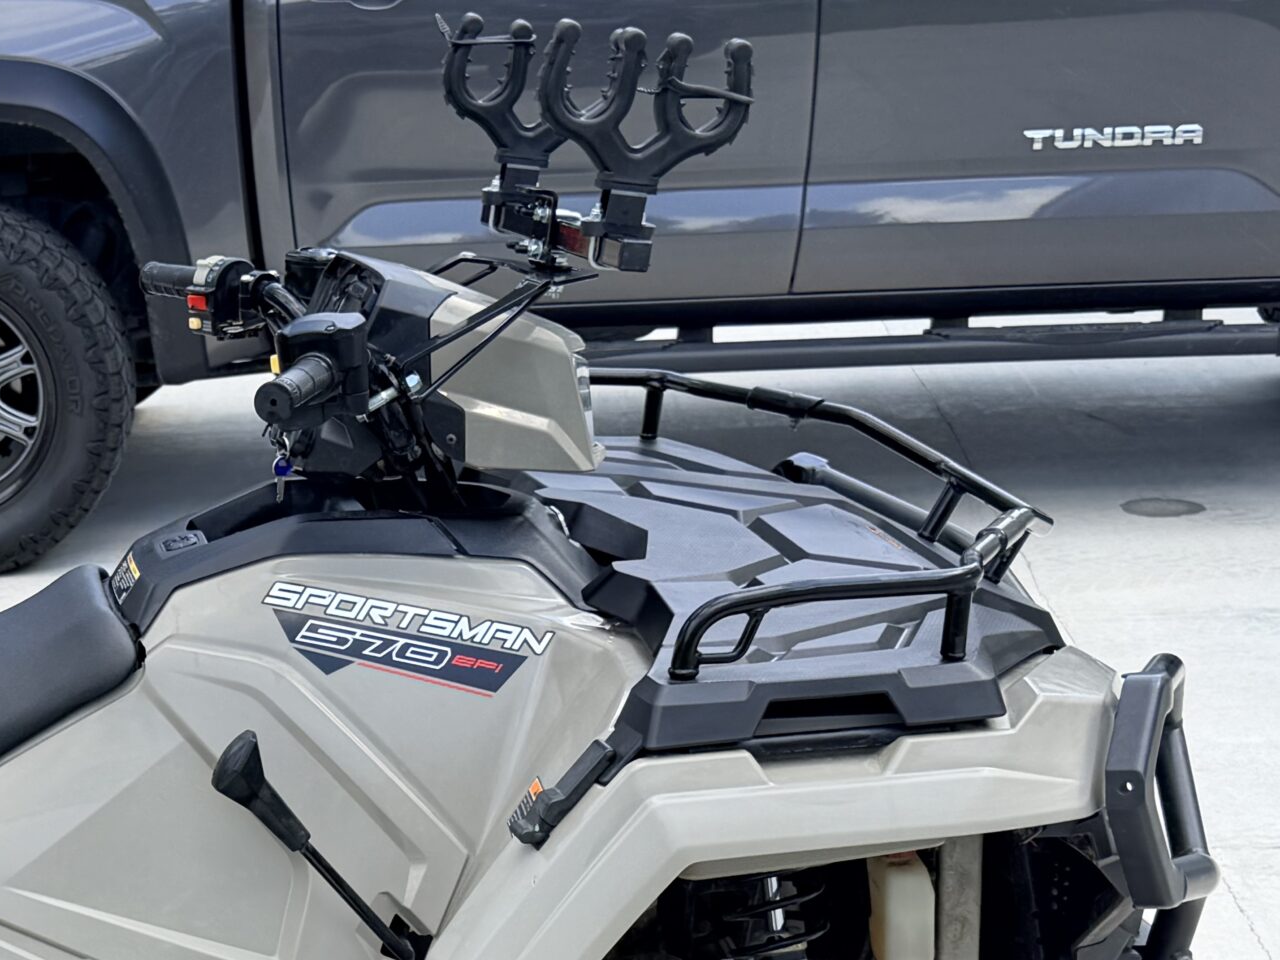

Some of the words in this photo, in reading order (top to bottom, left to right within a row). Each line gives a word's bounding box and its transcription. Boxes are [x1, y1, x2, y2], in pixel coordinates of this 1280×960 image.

[1023, 123, 1204, 150] TUNDRA
[263, 581, 556, 655] SPORTSMAN
[295, 619, 452, 670] 570
[451, 655, 503, 673] EFI
